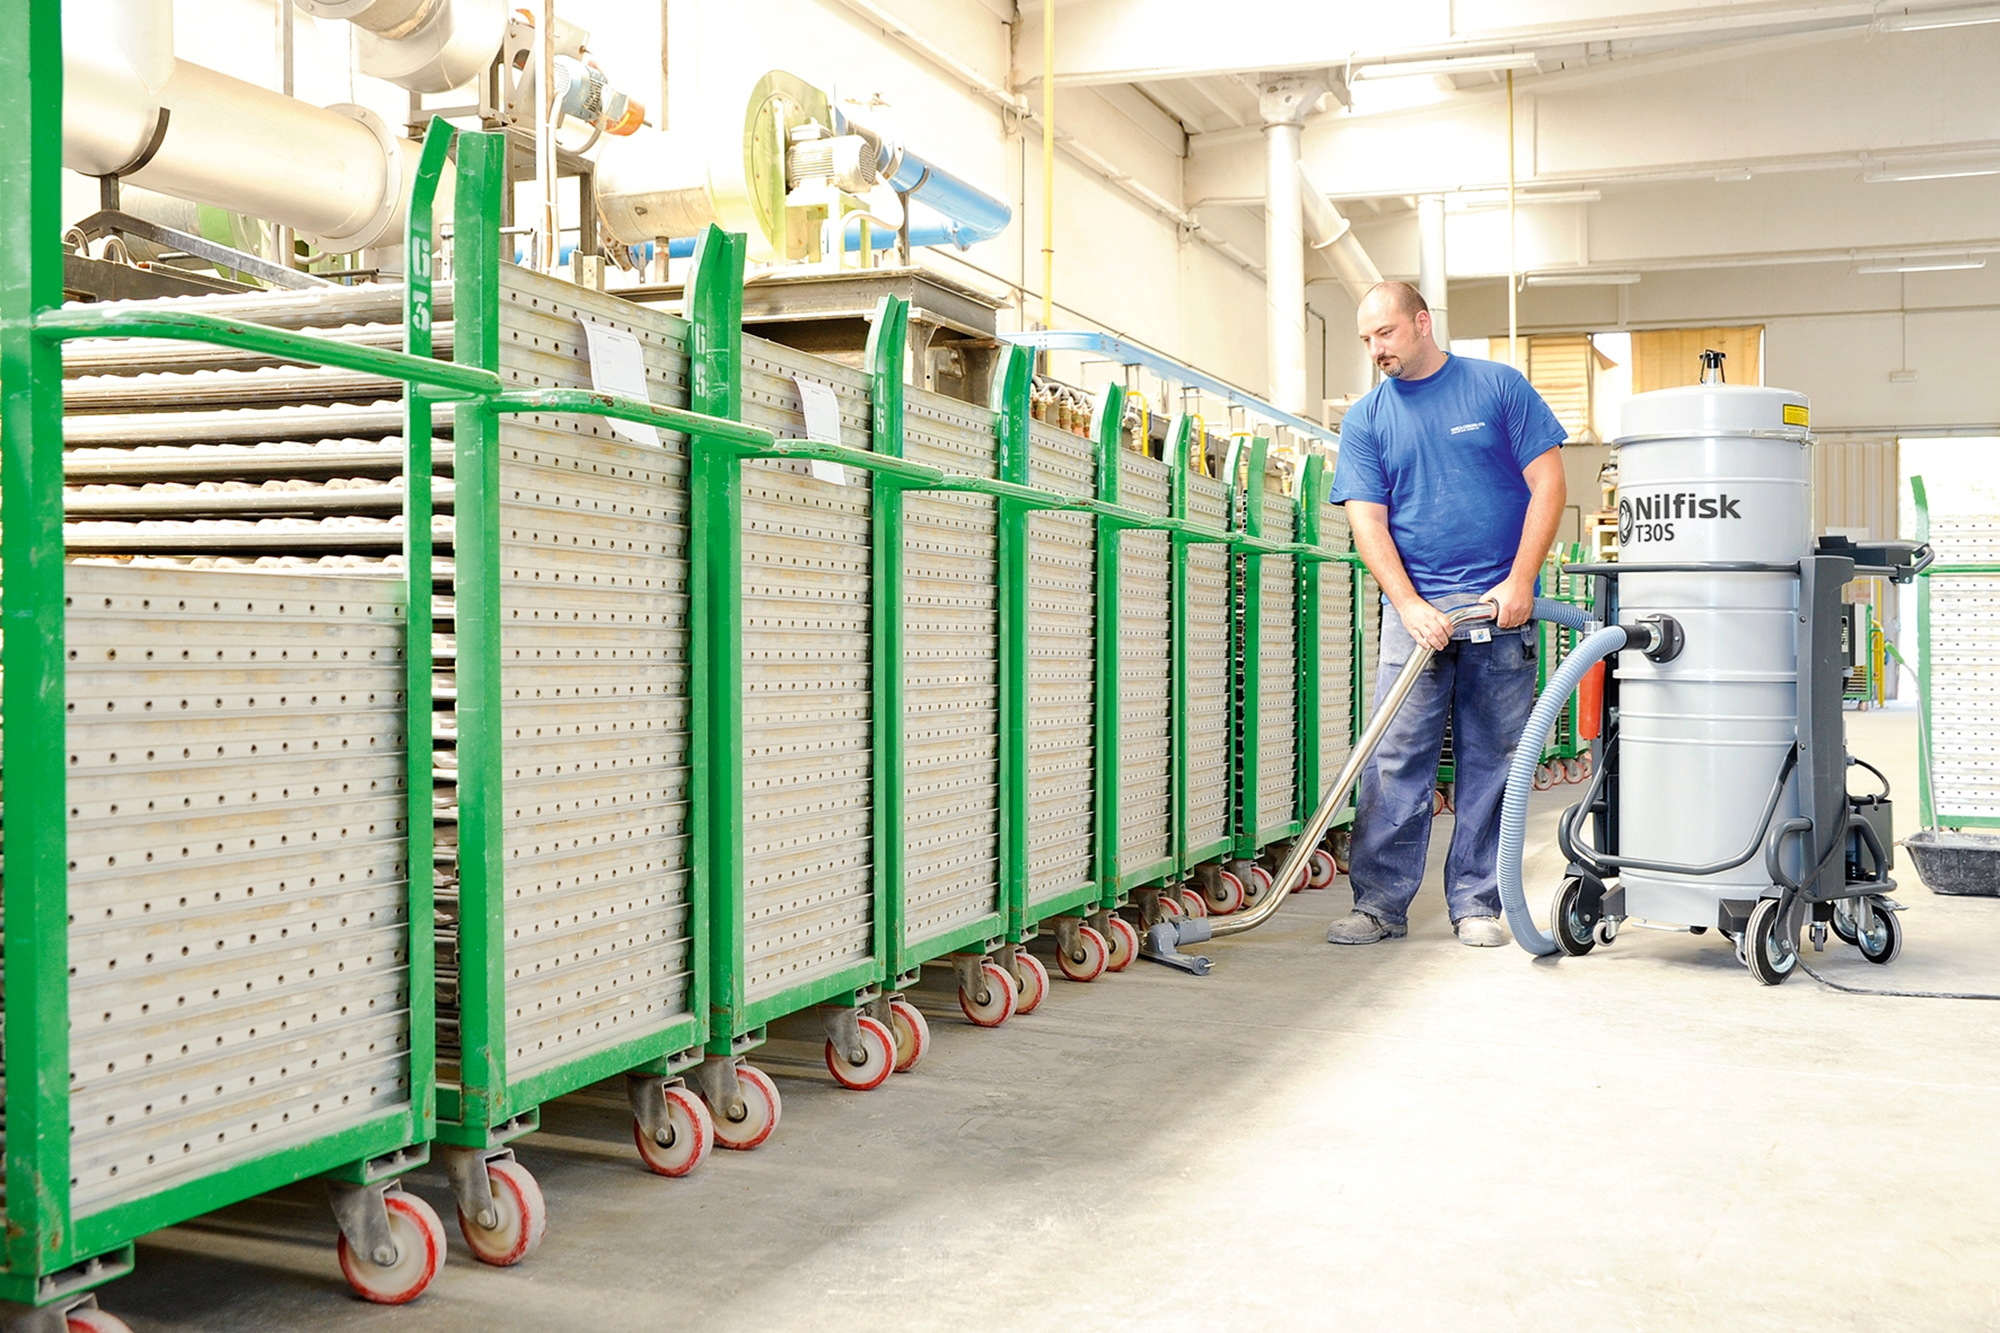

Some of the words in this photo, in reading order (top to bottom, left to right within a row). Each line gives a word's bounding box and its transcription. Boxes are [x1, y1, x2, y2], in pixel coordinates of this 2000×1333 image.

[877, 377, 885, 434] 15
[1635, 493, 1742, 520] Nilfisk
[1635, 523, 1675, 542] T30S
